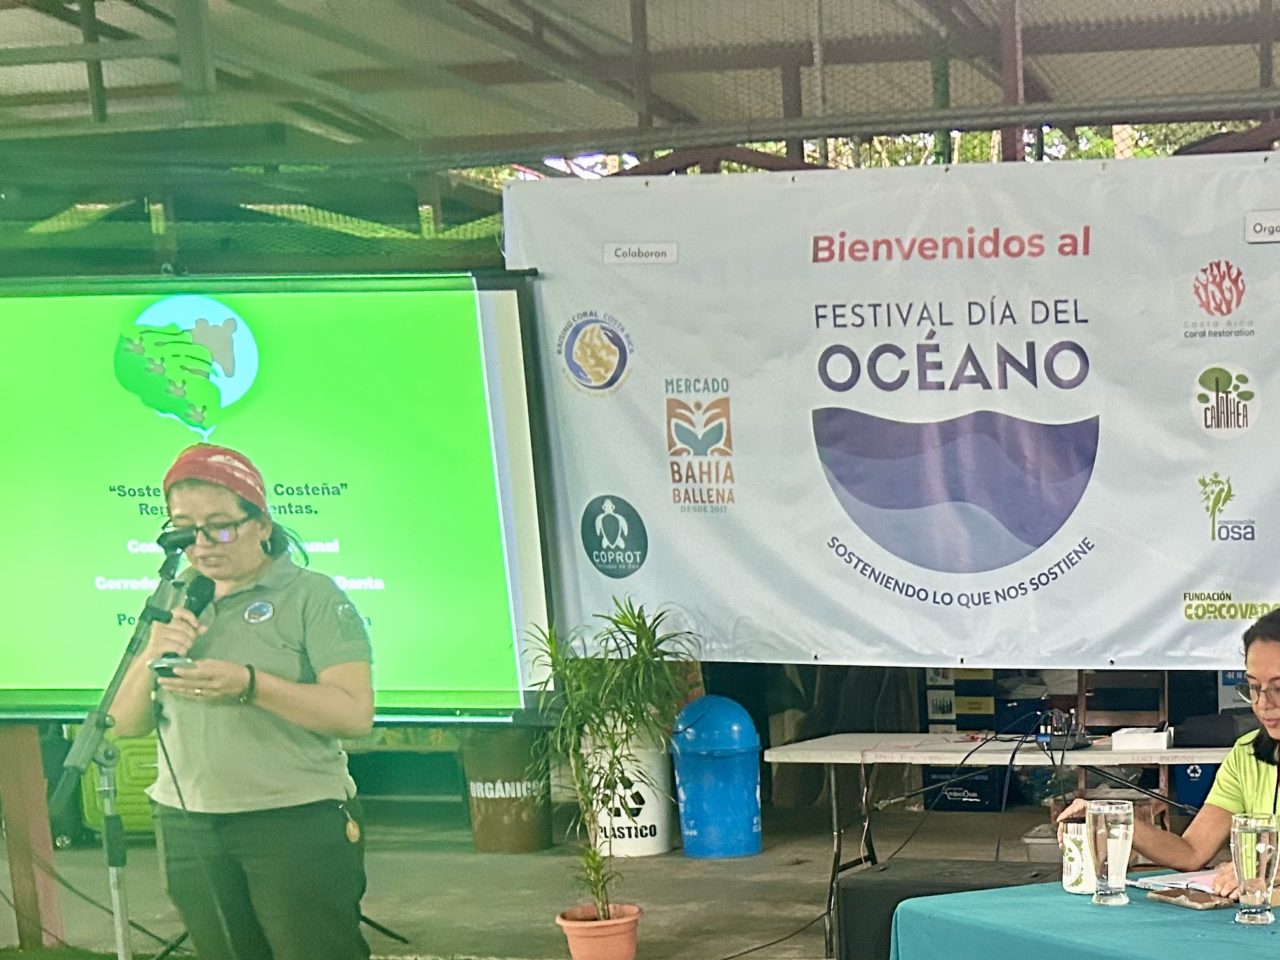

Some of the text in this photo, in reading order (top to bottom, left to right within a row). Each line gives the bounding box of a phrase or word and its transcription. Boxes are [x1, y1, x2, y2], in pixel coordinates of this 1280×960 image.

[812, 225, 1091, 263] Bienvenidos al
[614, 247, 667, 258] Colaboran
[814, 295, 1089, 328] FESTIVAL DÍA DEL
[817, 328, 1090, 393] OCÉANO
[665, 377, 730, 394] MERCADO
[672, 488, 735, 504] BALLENA
[1217, 525, 1255, 541] osa
[593, 551, 642, 563] COPROT
[827, 536, 1095, 609] SOSTENIENDO LO QUE NOS SOSTIENE
[1183, 591, 1232, 601] FUNDACIÓN
